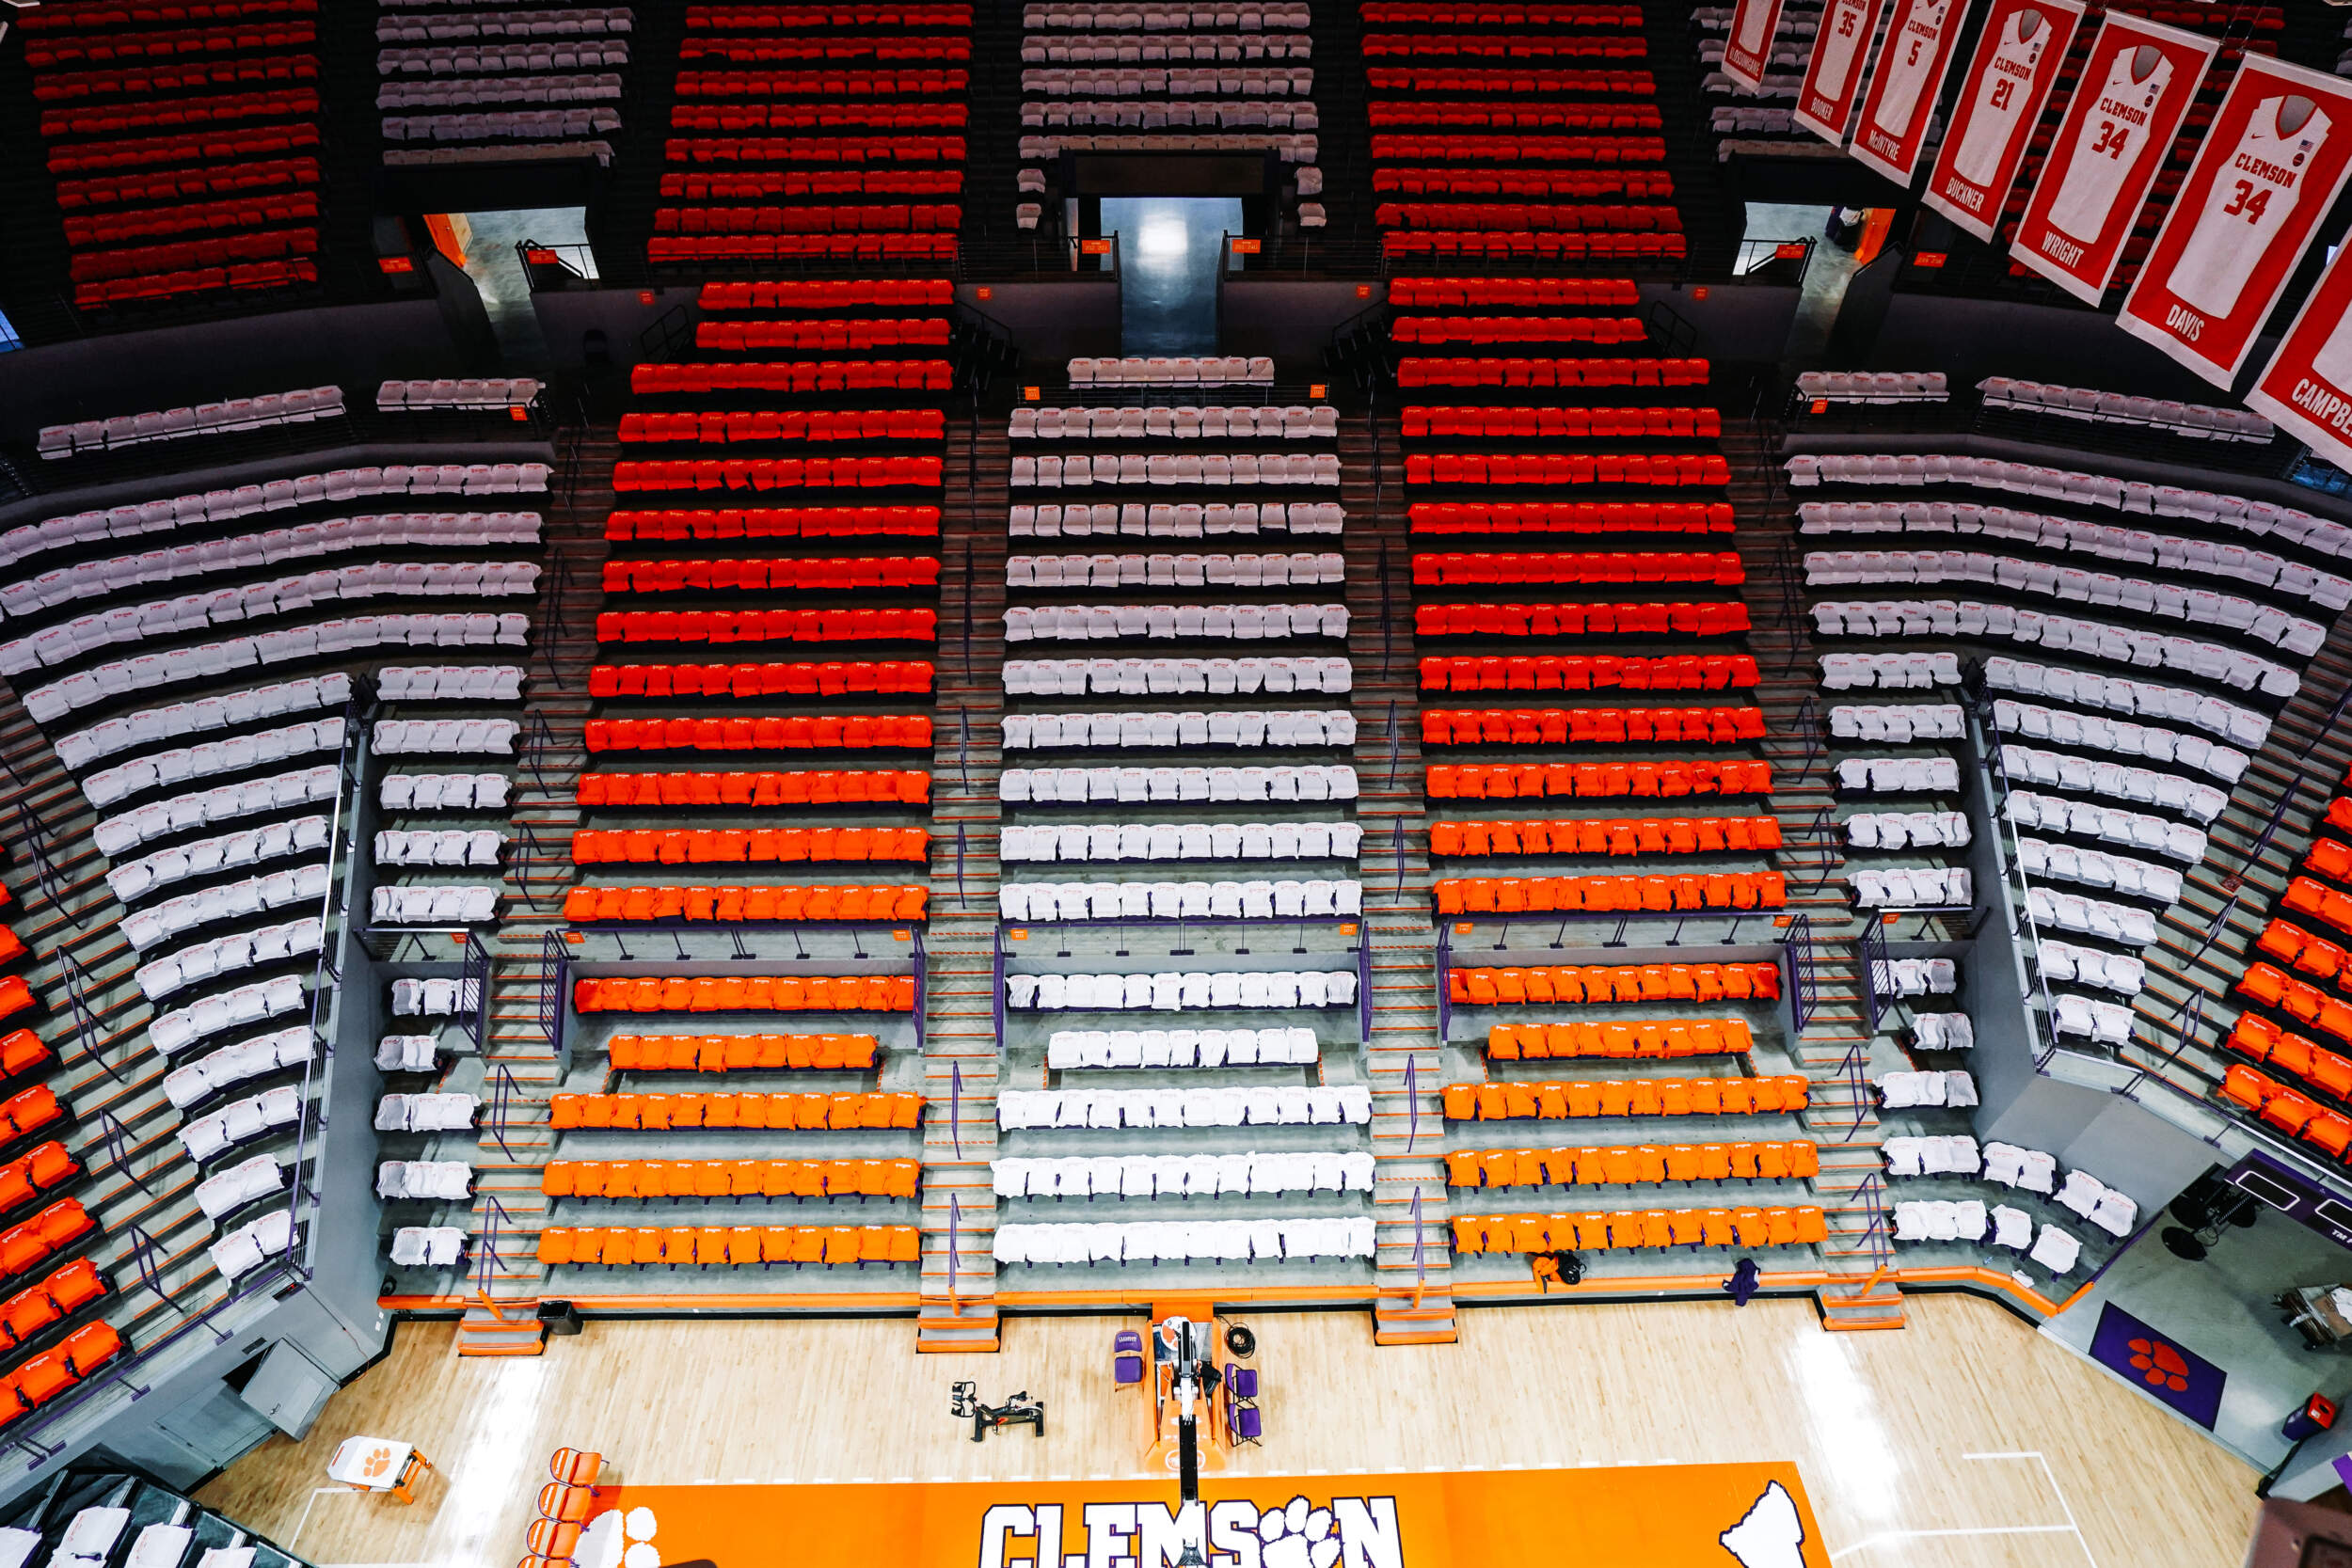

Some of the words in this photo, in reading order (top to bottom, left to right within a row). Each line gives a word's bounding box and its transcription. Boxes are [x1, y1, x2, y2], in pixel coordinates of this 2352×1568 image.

[1837, 10, 1857, 38] 35
[1907, 19, 1939, 41] CLEMSON
[1907, 40, 1922, 67] 5
[1994, 55, 2032, 81] CLEMSON
[1811, 97, 1834, 121] BOOKER
[1990, 78, 2015, 111] 21
[2099, 97, 2148, 127] CLEMSON
[1867, 129, 1900, 162] McINTYRE
[2091, 120, 2130, 161] 34
[2234, 152, 2297, 189] CLEMSON
[1946, 177, 1984, 213] BUCKNER
[2223, 179, 2273, 225] 34
[2041, 230, 2084, 269] WRIGHT
[2165, 304, 2205, 342] DAVIS
[2292, 377, 2352, 437] CAMPBE
